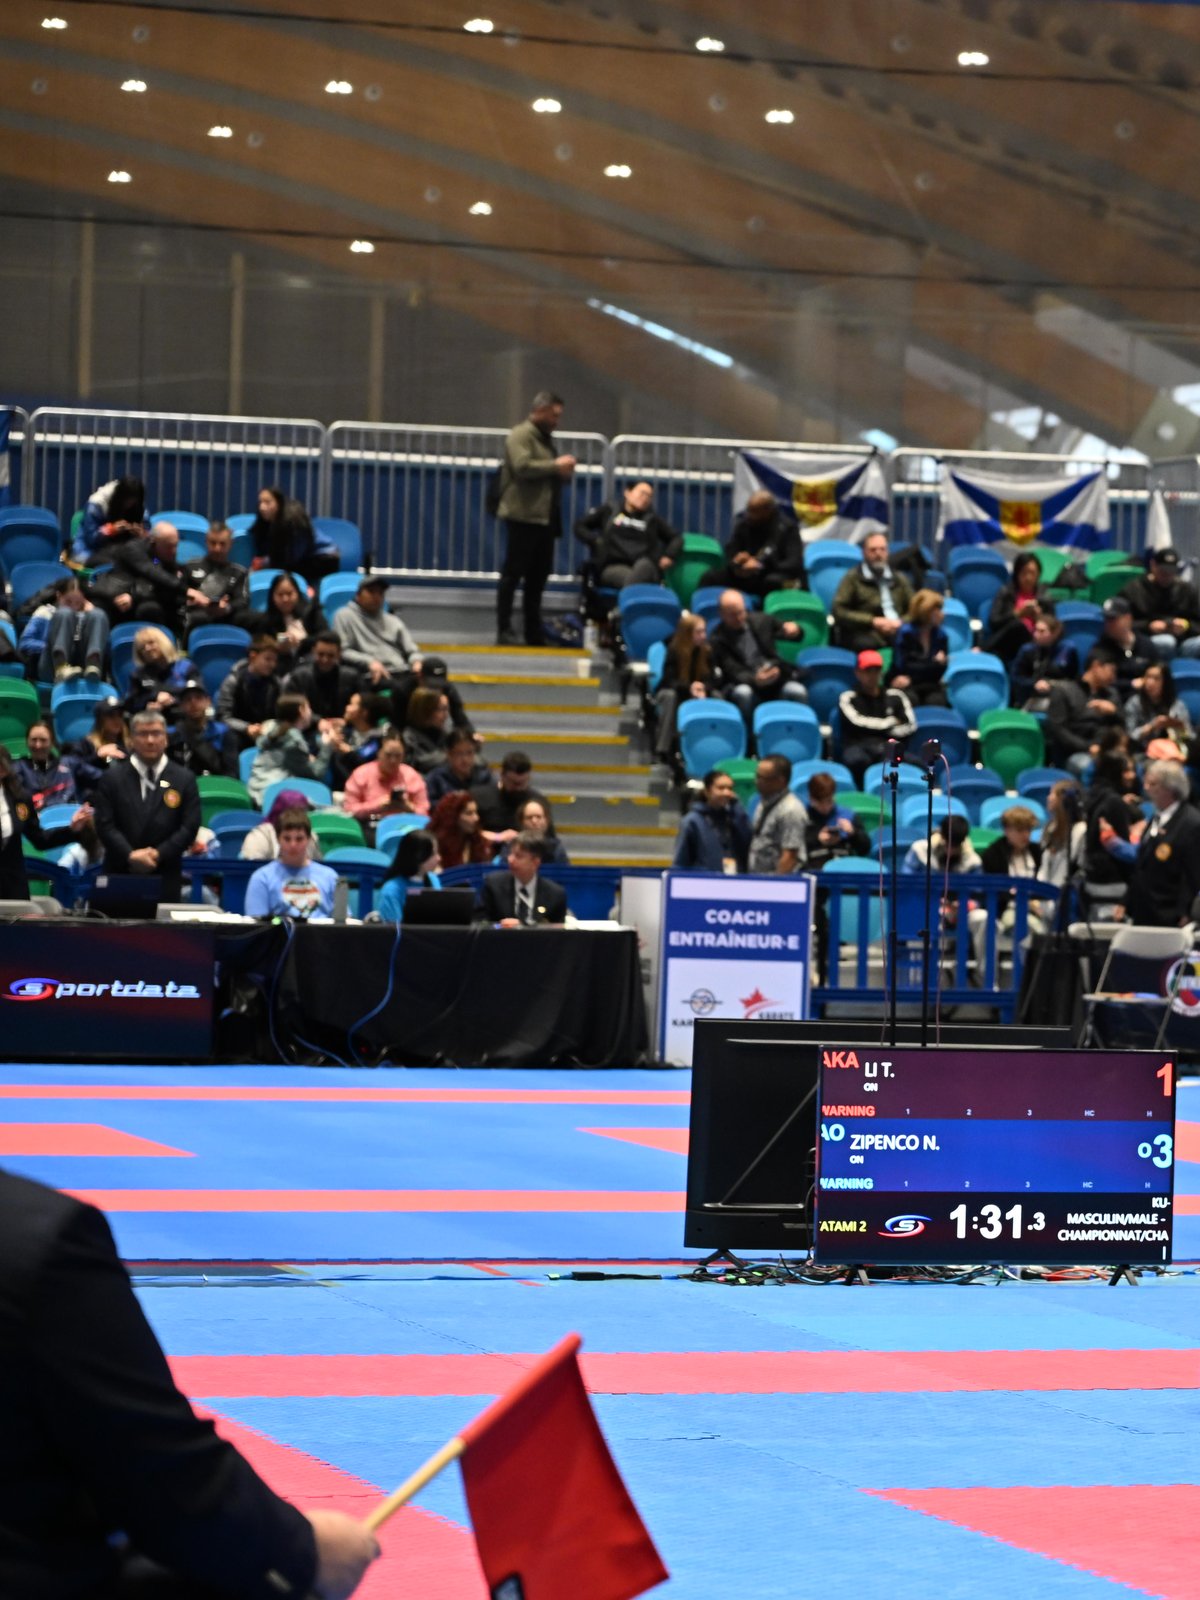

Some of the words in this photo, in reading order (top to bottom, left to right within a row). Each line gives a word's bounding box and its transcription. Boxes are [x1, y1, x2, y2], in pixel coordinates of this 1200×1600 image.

[705, 909, 770, 926] COACH
[880, 1061, 895, 1078] T.
[1156, 1062, 1173, 1097] 1
[863, 1082, 878, 1092] ON
[966, 1108, 972, 1116] 2
[1027, 1109, 1033, 1117] 3
[1084, 1109, 1095, 1117] HC
[849, 1134, 920, 1151] ZIPENCO
[922, 1135, 940, 1151] N.
[849, 1155, 864, 1165] ON
[904, 1180, 909, 1188] 1
[964, 1180, 970, 1188] 2
[1082, 1181, 1093, 1189] HC
[1066, 1213, 1158, 1226] MASCULIN/MALE
[819, 1220, 857, 1233] ATAMI
[858, 1220, 867, 1233] 2
[1057, 1229, 1169, 1242] CHAMPIONNAT/CHA
